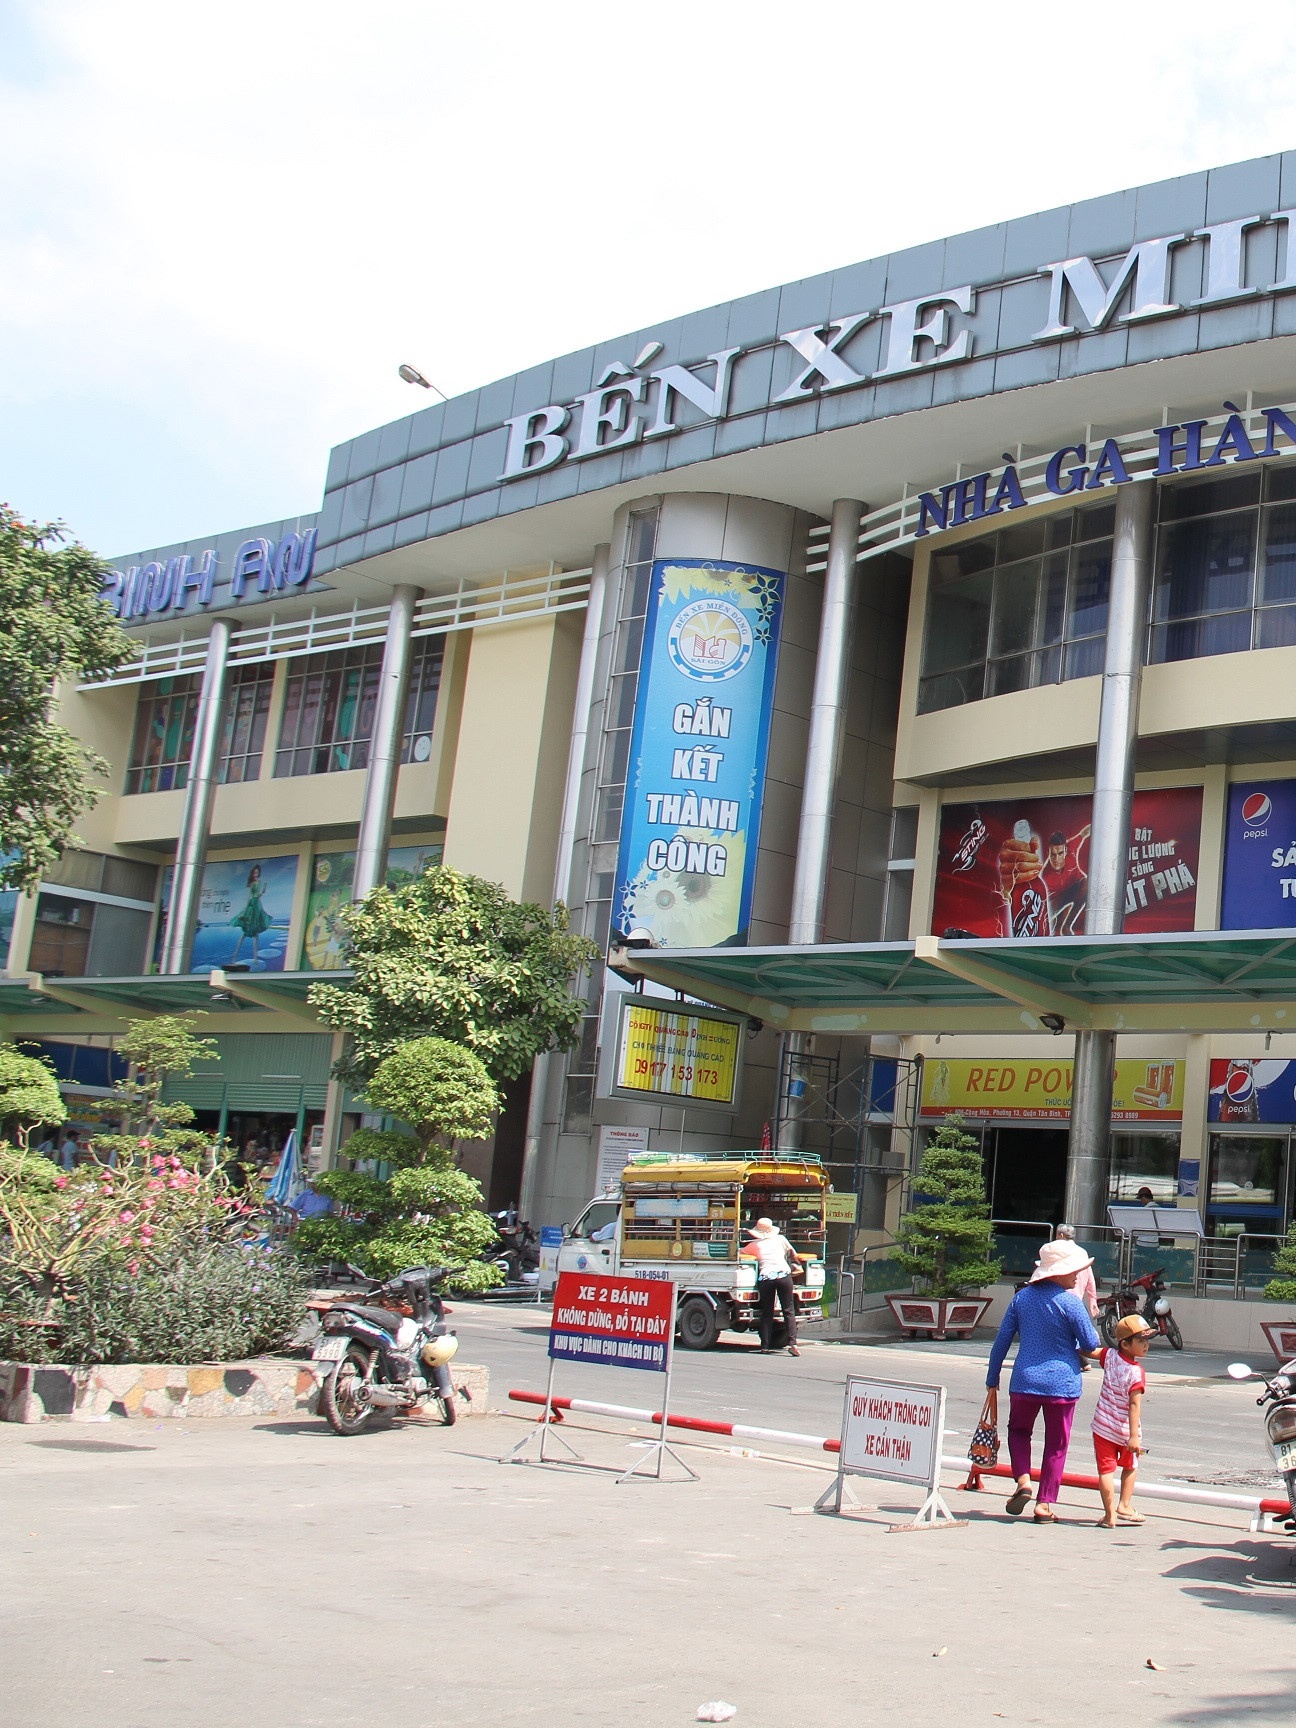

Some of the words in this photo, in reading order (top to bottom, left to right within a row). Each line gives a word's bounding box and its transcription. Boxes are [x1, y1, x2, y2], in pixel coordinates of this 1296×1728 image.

[497, 341, 742, 482] BẾN
[774, 286, 976, 402] XE
[914, 453, 1028, 537] NHÀ
[1045, 438, 1133, 495] GA
[231, 528, 318, 598] AN
[691, 604, 704, 614] XE
[672, 696, 732, 739] GẮN
[671, 744, 724, 783] KẾT
[646, 788, 740, 832] THÀNH
[961, 825, 986, 861] STING
[1135, 827, 1152, 842] BẬT
[1142, 840, 1175, 858] LƯỢNG
[1243, 829, 1268, 839] pepsi
[647, 834, 727, 877] CÔNG
[1131, 861, 1154, 877] SỐNG
[1151, 858, 1196, 901] PHÁ
[671, 1065, 693, 1081] 153
[697, 1068, 718, 1085] 173
[965, 1067, 1016, 1093] RED
[1228, 1105, 1250, 1115] pepsi
[578, 1286, 596, 1301] XE
[599, 1288, 608, 1303] 2
[610, 1286, 649, 1306] BÁNH
[557, 1306, 587, 1326] KHÔNG
[616, 1308, 628, 1331] ĐỖ
[630, 1315, 645, 1337] TẠI
[647, 1315, 667, 1335] ĐÂY
[554, 1335, 568, 1350] KHU
[569, 1336, 582, 1354] VỰC
[583, 1335, 601, 1354] DÀNH
[602, 1340, 617, 1357] CHO
[618, 1341, 642, 1360] KHÁCH
[653, 1344, 664, 1365] BỘ
[853, 1392, 868, 1418] QUÝ
[868, 1394, 893, 1421] KHÁCH
[894, 1398, 918, 1426] TRÔNG
[918, 1405, 932, 1428] COI
[865, 1434, 875, 1455] XE
[876, 1426, 891, 1458] CẨN
[892, 1435, 912, 1467] THẬN
